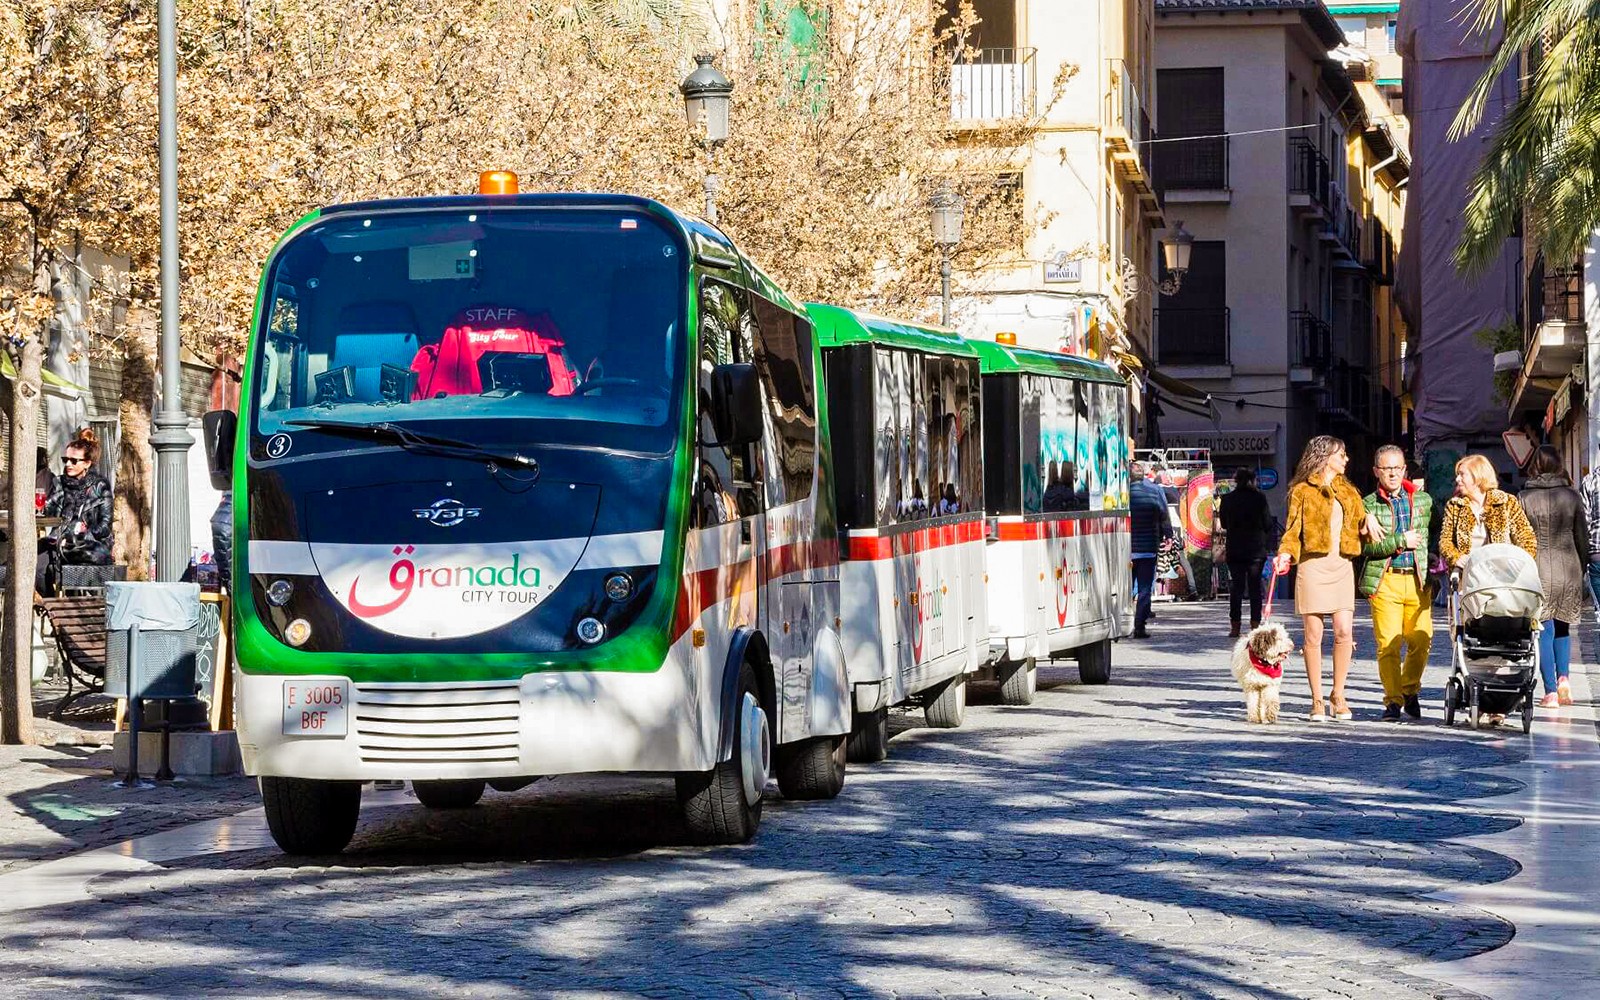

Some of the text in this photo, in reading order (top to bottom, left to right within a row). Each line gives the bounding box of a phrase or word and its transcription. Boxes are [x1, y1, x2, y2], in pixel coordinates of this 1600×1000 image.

[465, 308, 518, 322] STAFF
[1198, 437, 1235, 451] FRUTOS
[1239, 437, 1270, 451] SECOS
[462, 590, 538, 604] CITY TOUR
[289, 686, 342, 705] E 3005
[301, 711, 328, 729] BGF
